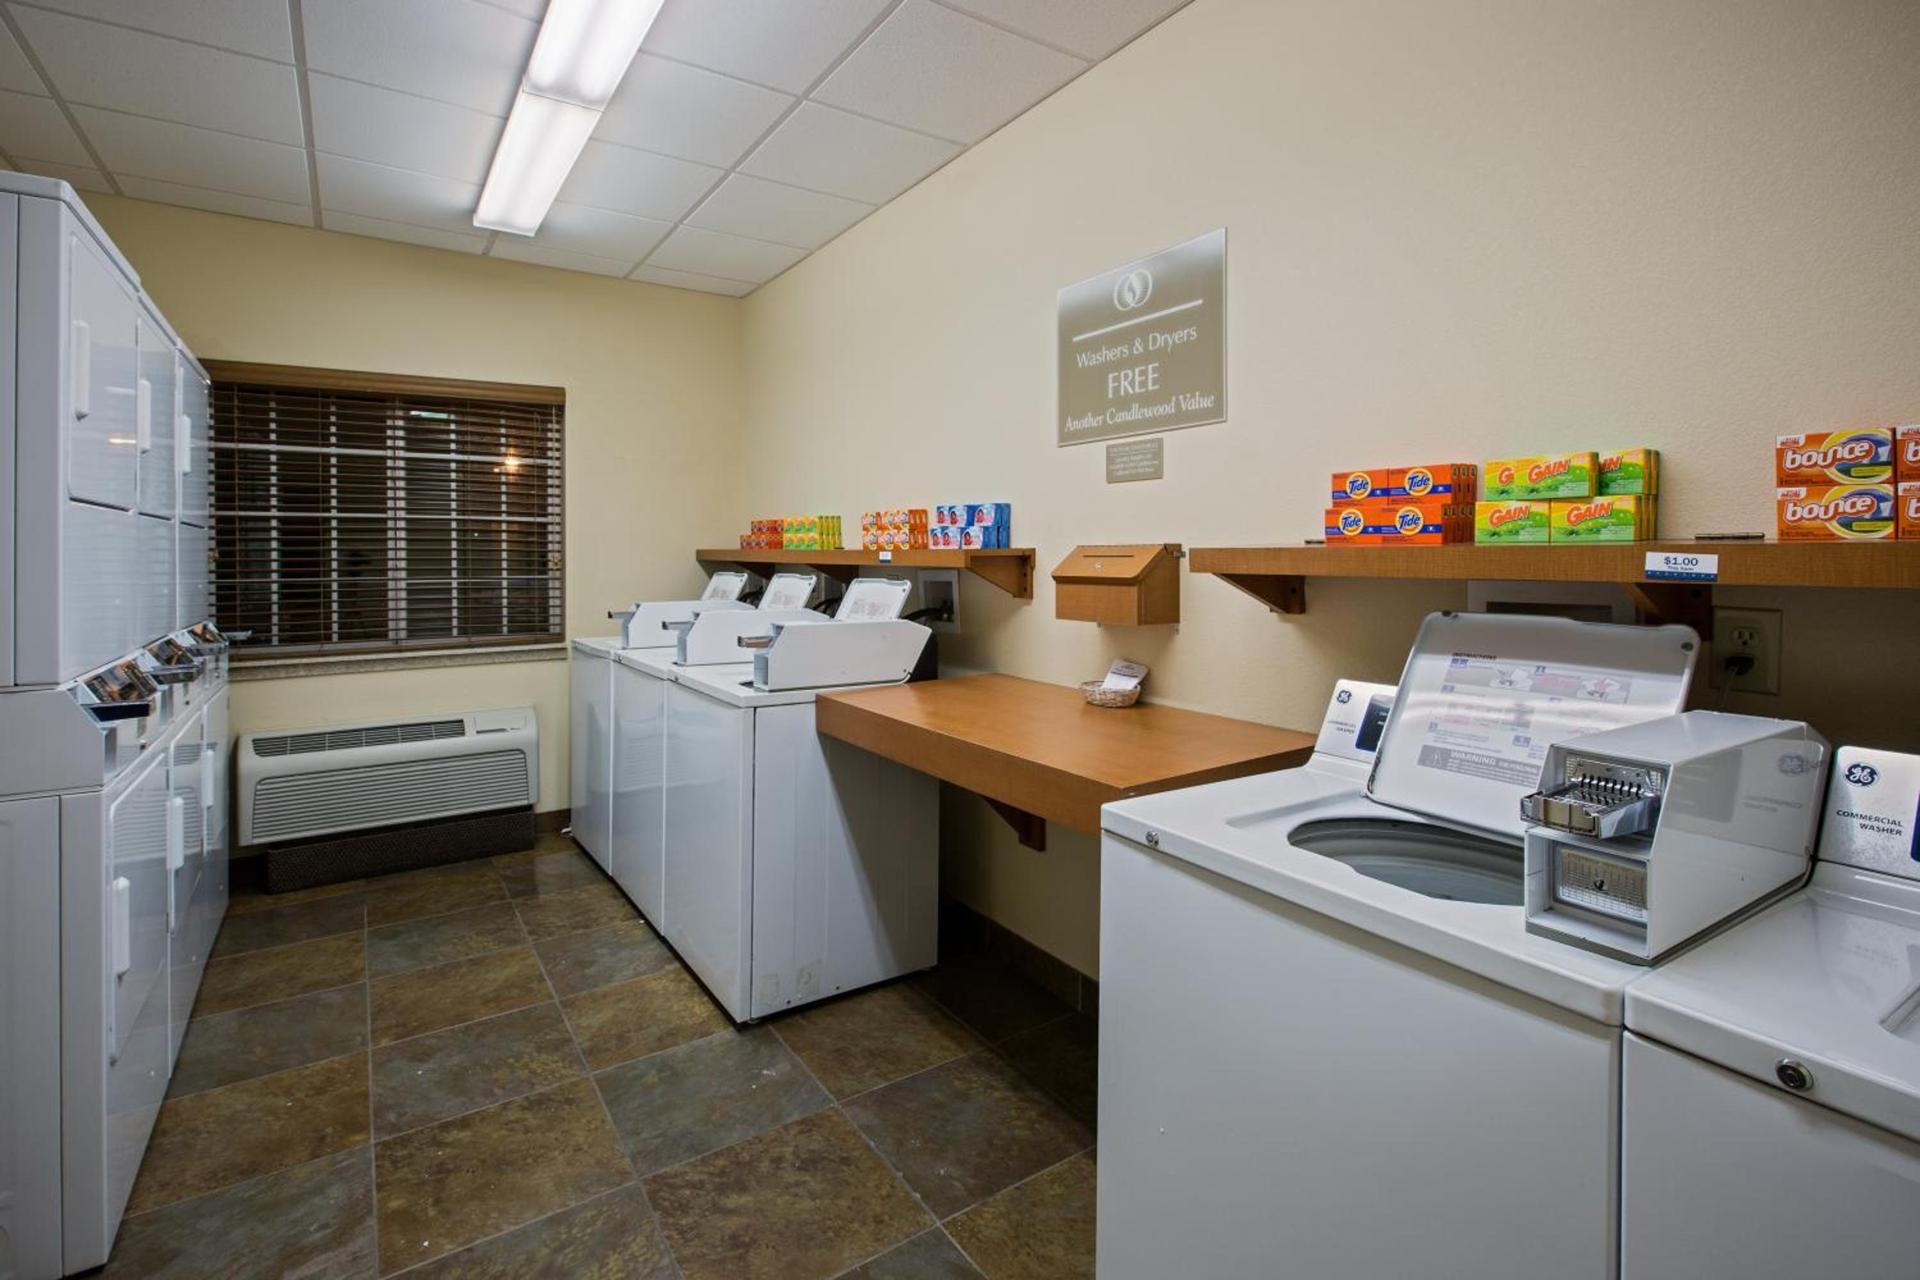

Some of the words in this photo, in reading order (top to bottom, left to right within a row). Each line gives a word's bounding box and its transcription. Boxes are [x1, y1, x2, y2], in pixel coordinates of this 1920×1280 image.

[1076, 345, 1129, 368] Washers
[1132, 337, 1143, 354] &
[1149, 326, 1198, 352] Dryers
[1107, 363, 1160, 398] FREE
[1065, 409, 1103, 432] Another
[1106, 397, 1175, 424] Candlewood
[1179, 392, 1215, 410] Value
[1784, 439, 1872, 470] bounce
[1349, 479, 1369, 494] Tide
[1407, 474, 1430, 490] Tide
[1785, 496, 1874, 522] bounce
[1342, 515, 1361, 530] Tide
[1398, 513, 1420, 529] Tide
[1664, 556, 1698, 566] $1.00
[1836, 809, 1903, 827] COMMERCIAL
[1859, 823, 1902, 836] WASHER
